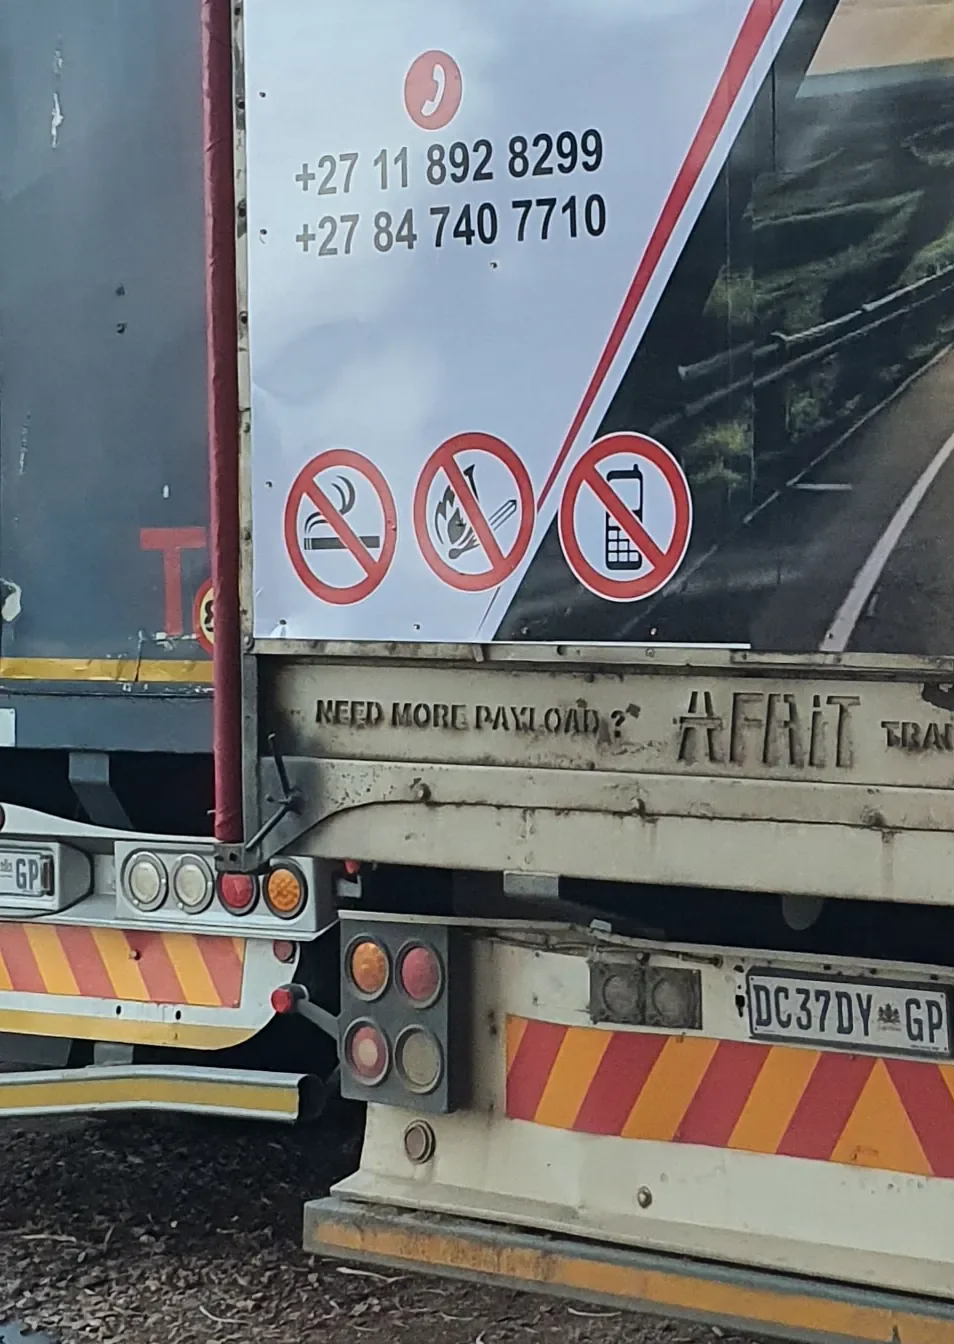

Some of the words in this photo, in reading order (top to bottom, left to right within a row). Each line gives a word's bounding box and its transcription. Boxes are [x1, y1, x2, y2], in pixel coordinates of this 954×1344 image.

[295, 153, 359, 195] +27
[373, 147, 409, 191] 11
[426, 139, 494, 185] 892
[507, 129, 603, 177] 8299
[295, 213, 359, 256] +27
[373, 208, 417, 252] 84
[430, 202, 498, 247] 740
[512, 194, 606, 241] 7710
[316, 699, 381, 729] NEED
[392, 702, 466, 731] MORE
[16, 859, 38, 889] GP
[753, 984, 872, 1036] DC37DY
[905, 998, 942, 1043] GP
